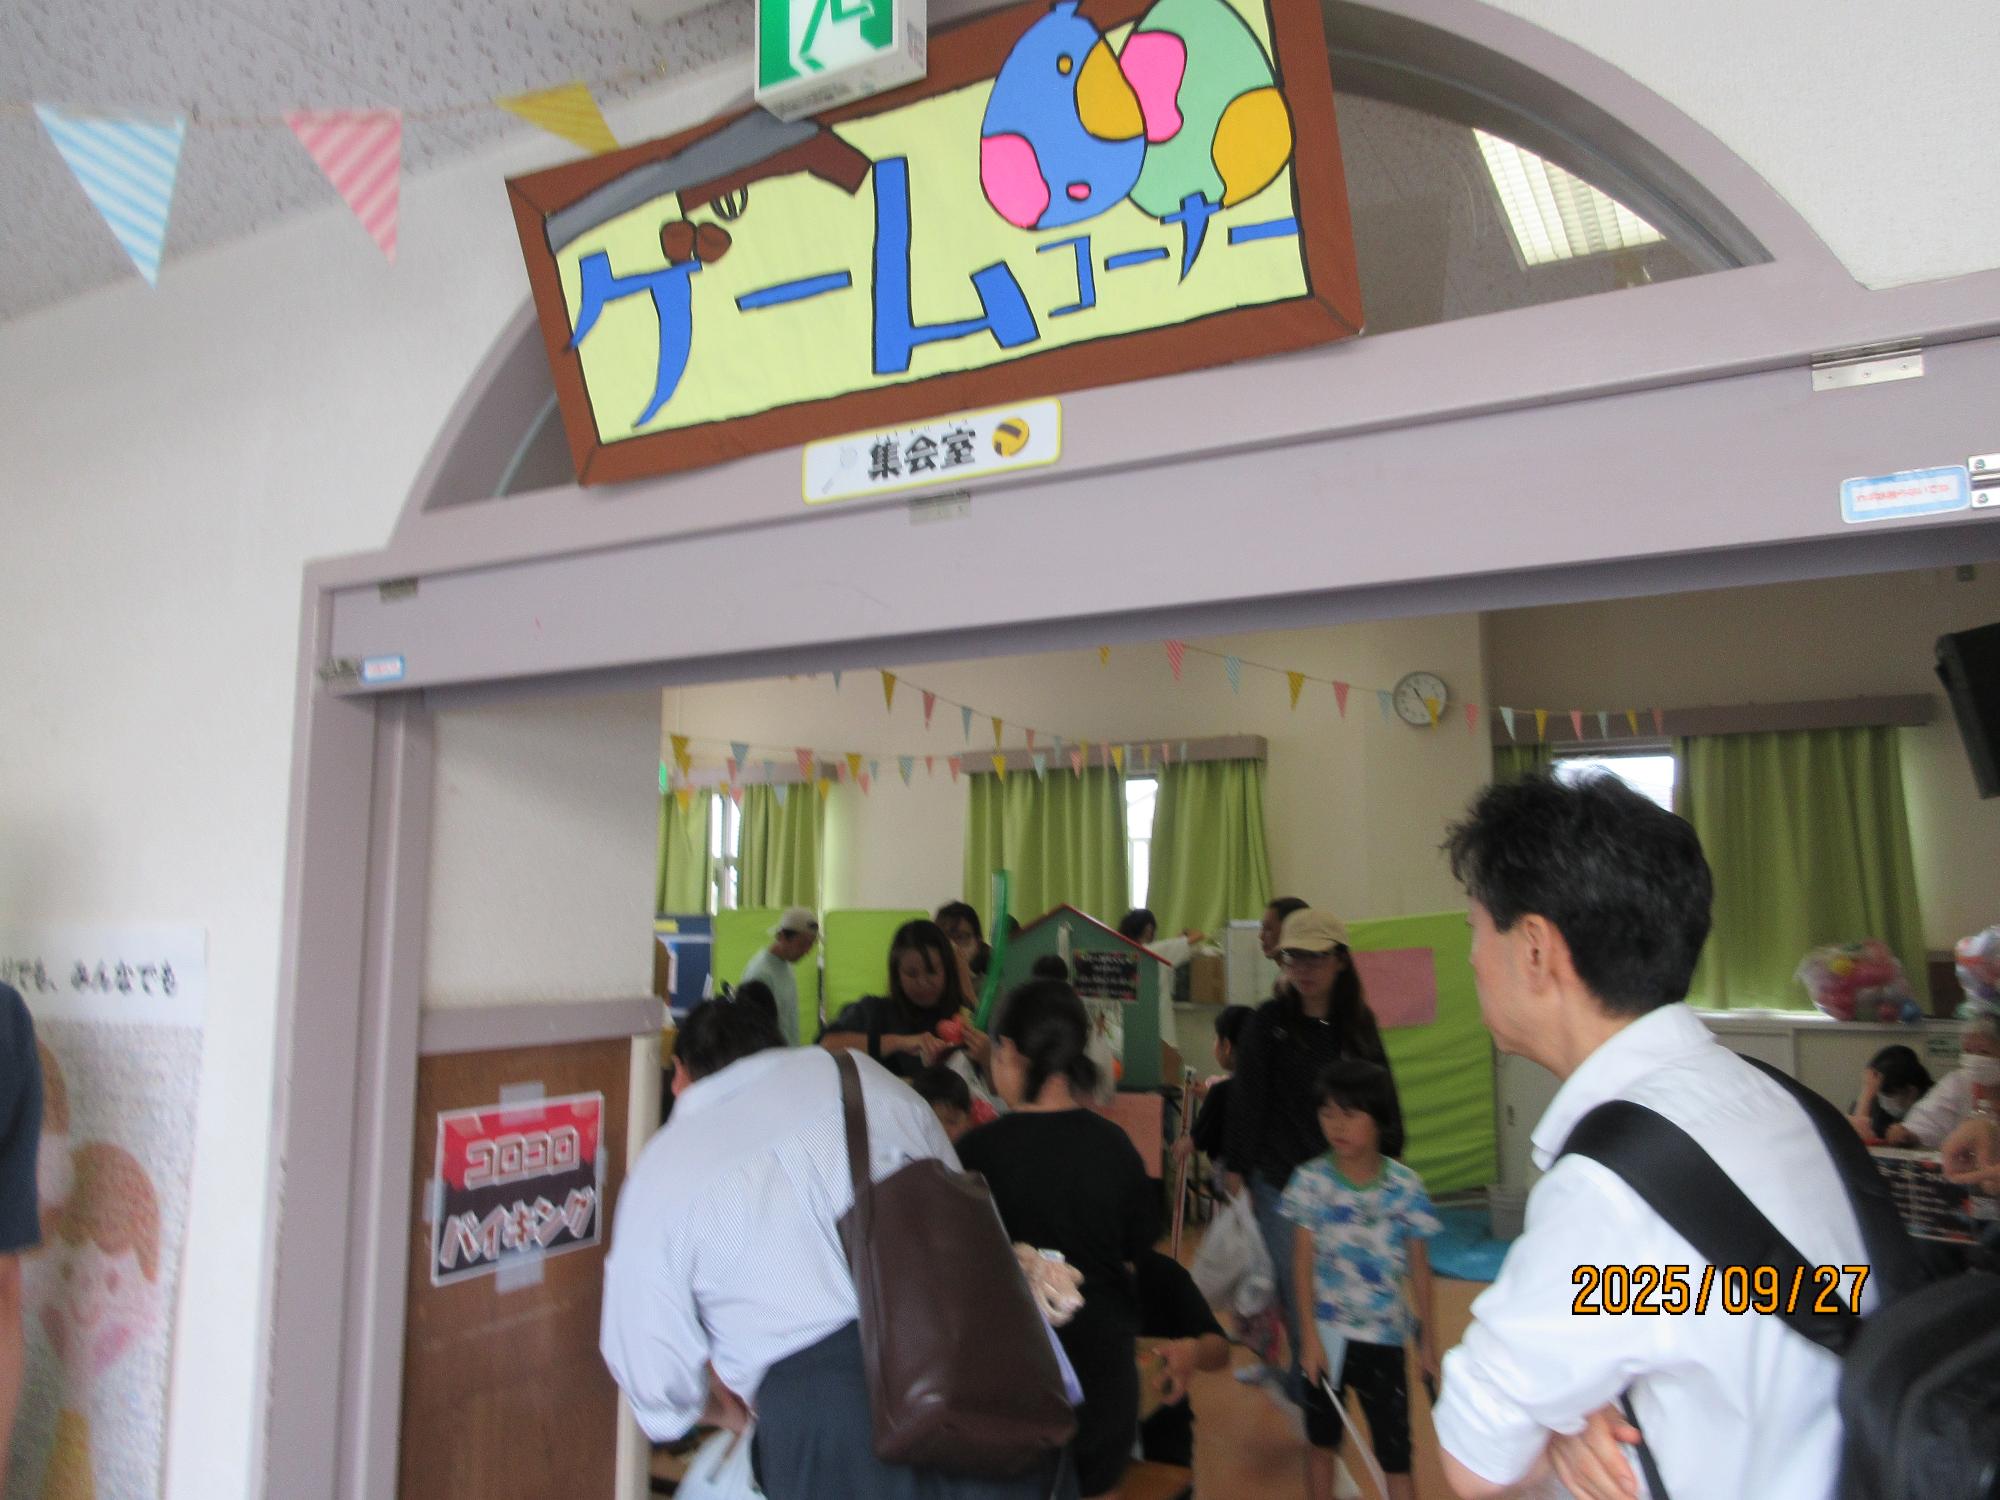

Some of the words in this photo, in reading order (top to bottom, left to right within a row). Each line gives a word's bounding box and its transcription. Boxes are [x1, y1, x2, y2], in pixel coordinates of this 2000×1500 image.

[565, 154, 1300, 429] ゲームコーナー
[867, 426, 977, 481] 集会室
[463, 1124, 580, 1191] コロコロ
